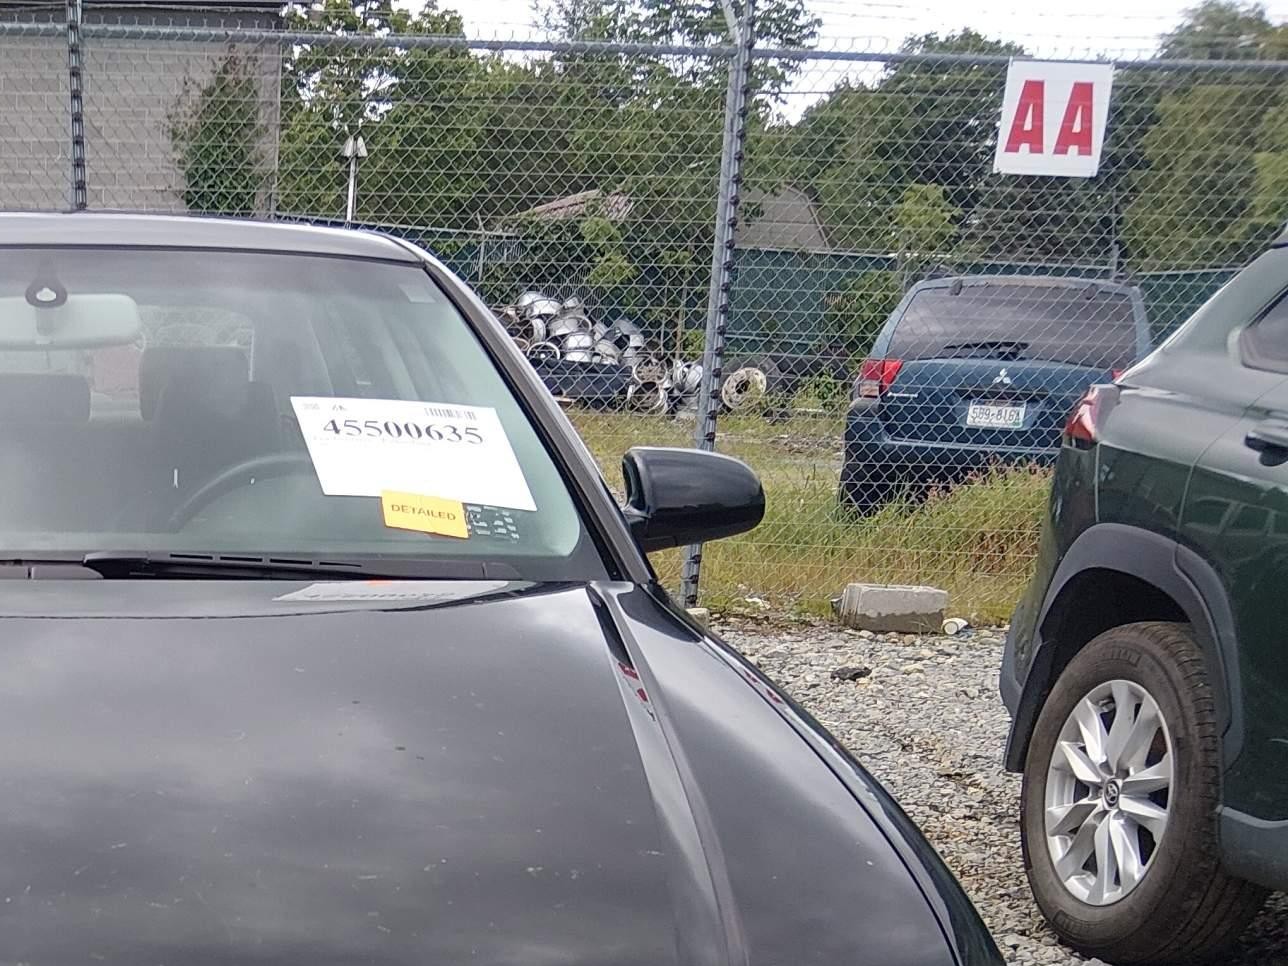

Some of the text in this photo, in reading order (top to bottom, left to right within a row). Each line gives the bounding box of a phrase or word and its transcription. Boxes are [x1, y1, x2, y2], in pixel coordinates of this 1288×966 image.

[1003, 79, 1094, 157] AA
[322, 418, 484, 445] 45500635
[391, 504, 456, 521] DETAILED
